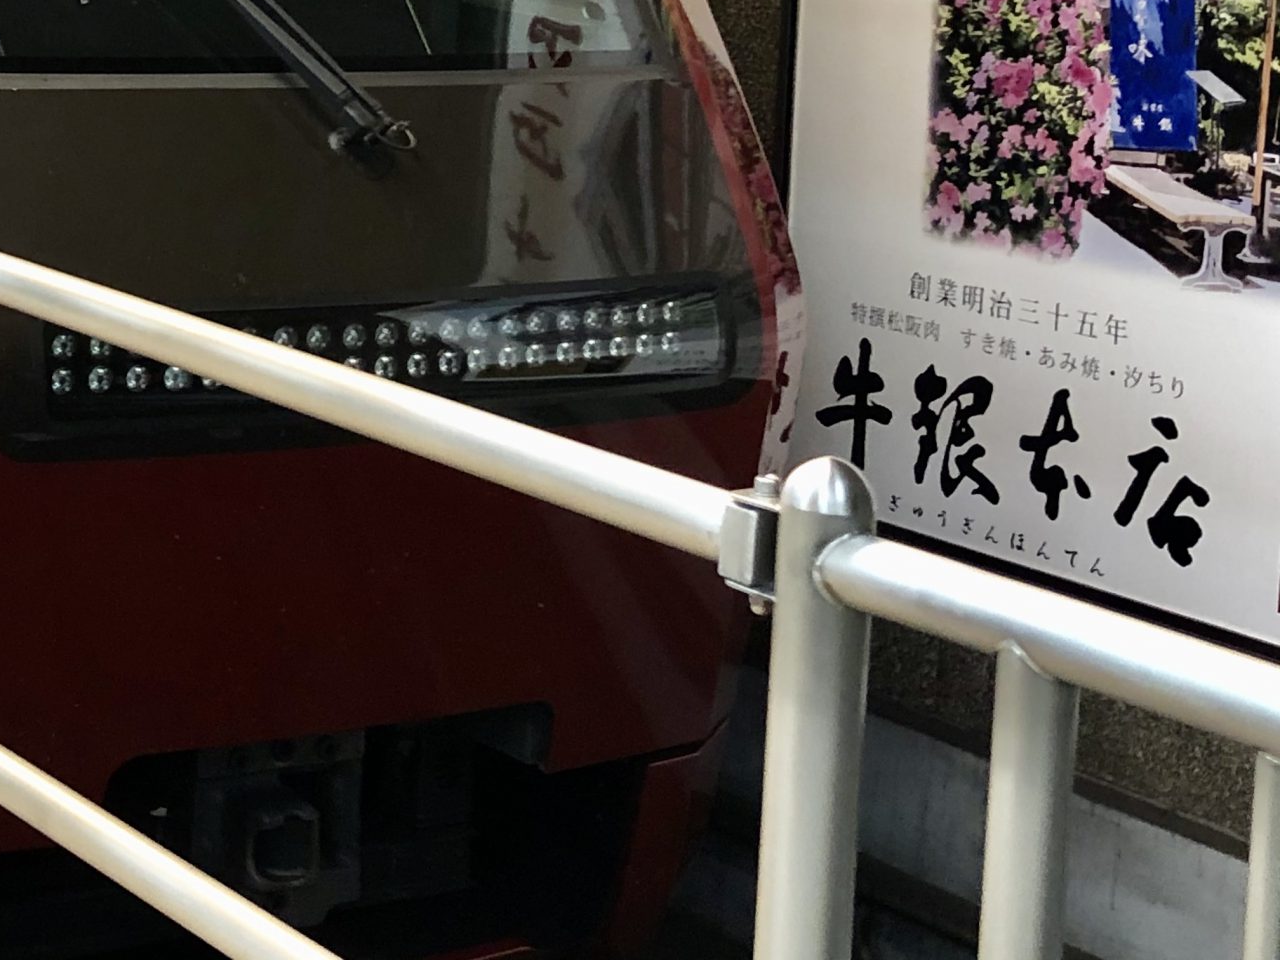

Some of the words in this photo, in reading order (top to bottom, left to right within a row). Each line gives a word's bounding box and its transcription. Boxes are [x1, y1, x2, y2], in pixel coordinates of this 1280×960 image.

[850, 302, 941, 342] 特撰松阪肉
[908, 272, 1130, 345] 創業明治三十五年
[815, 338, 1210, 567] 牛銀本店
